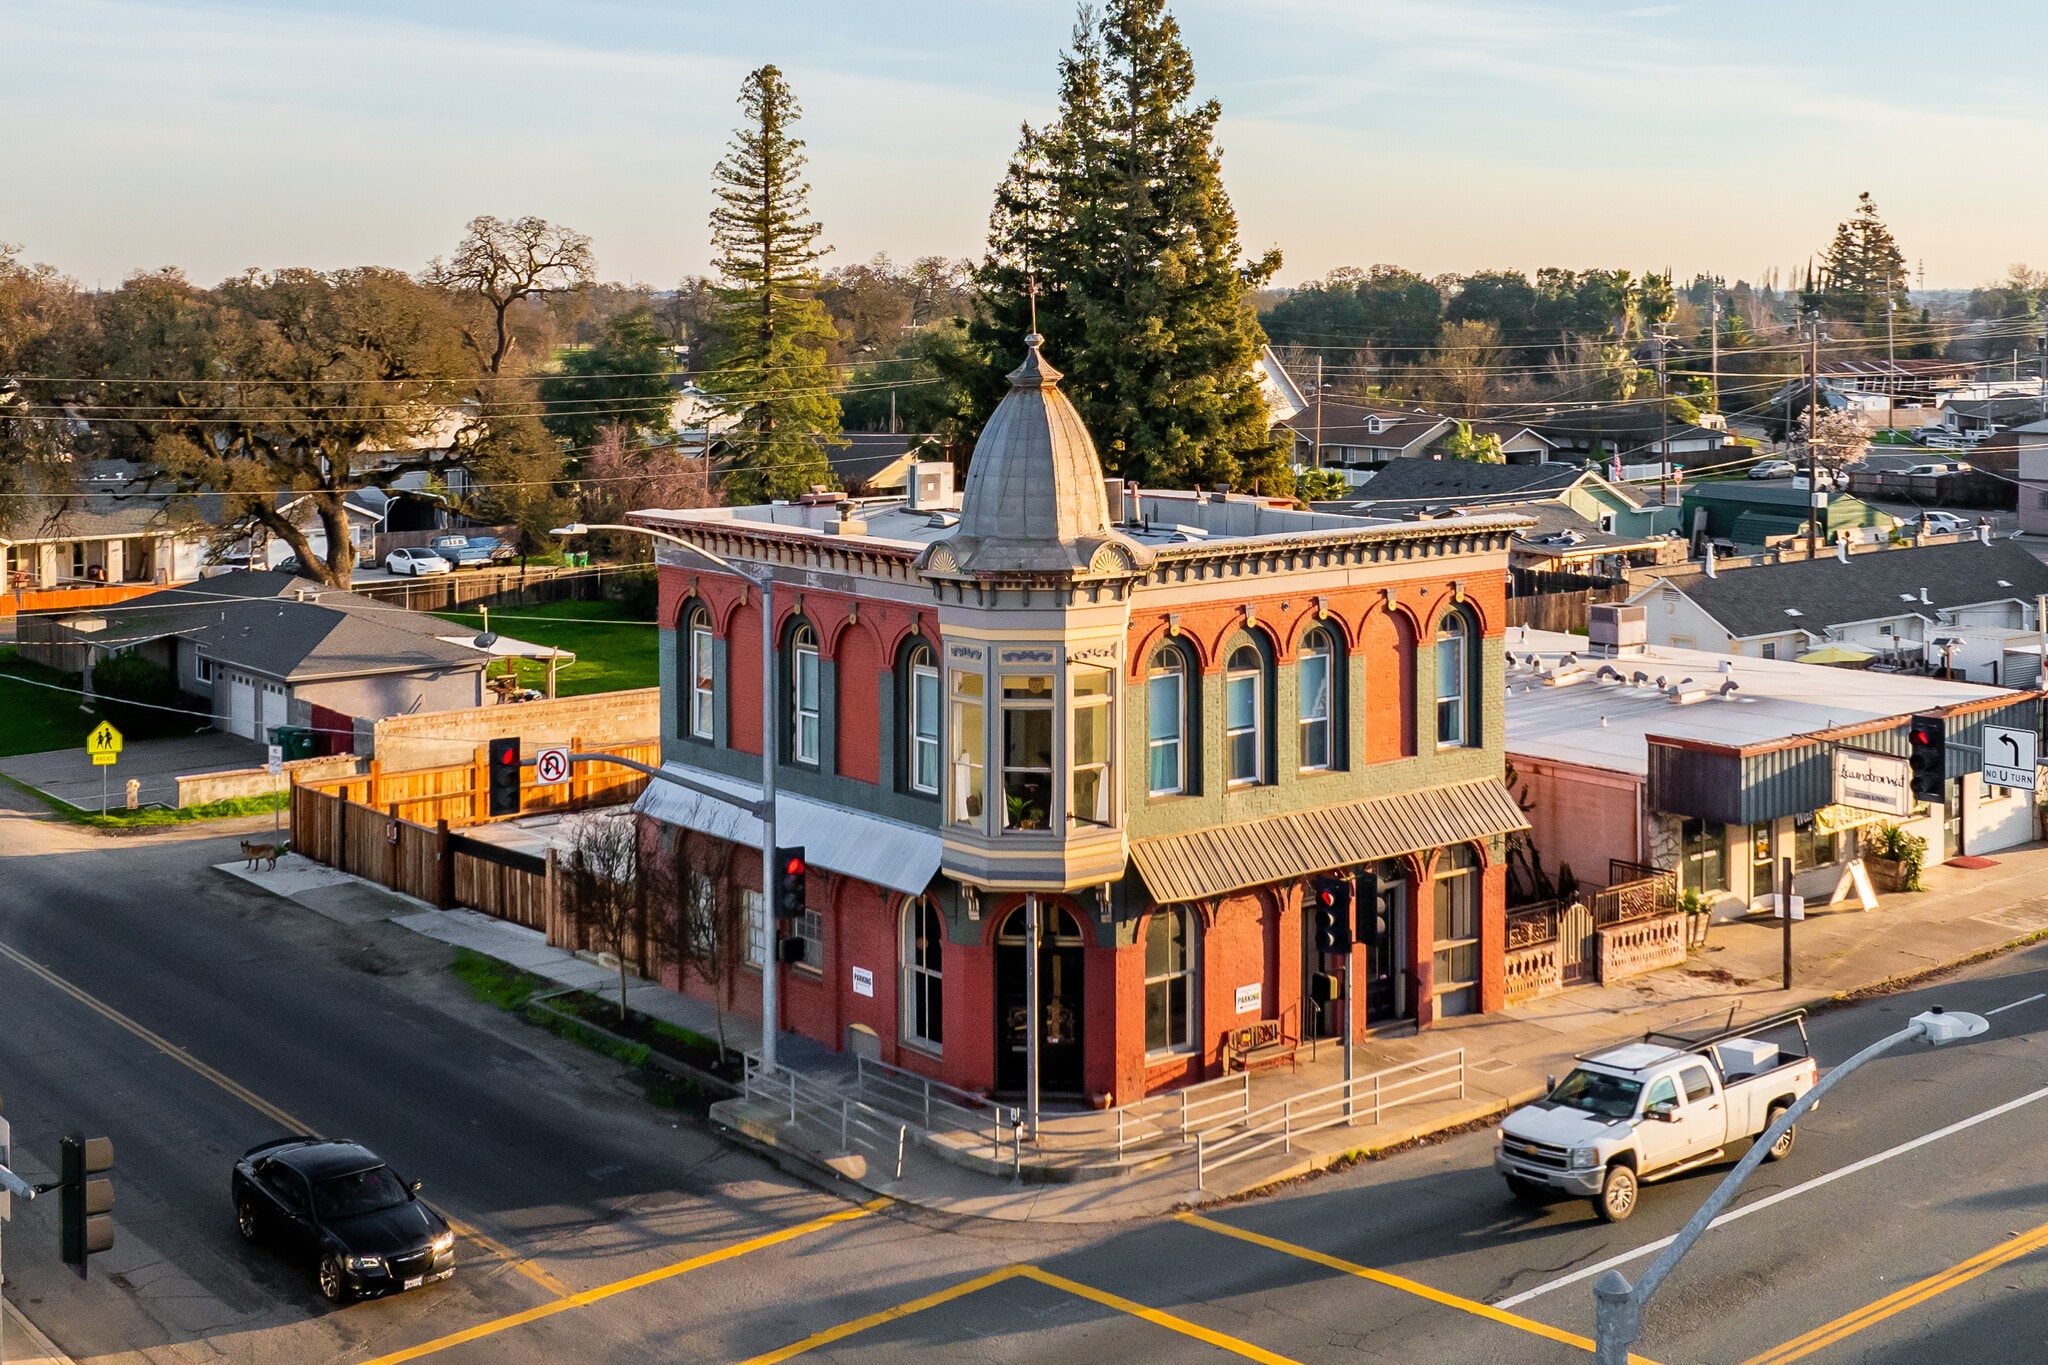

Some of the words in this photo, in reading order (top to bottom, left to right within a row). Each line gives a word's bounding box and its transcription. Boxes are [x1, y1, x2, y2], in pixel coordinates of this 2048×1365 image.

[1986, 770, 1997, 779] NO
[1999, 770, 2008, 782] U
[2010, 773, 2033, 784] TURN
[854, 972, 872, 986] PARKING
[1237, 992, 1260, 1005] PARKING
